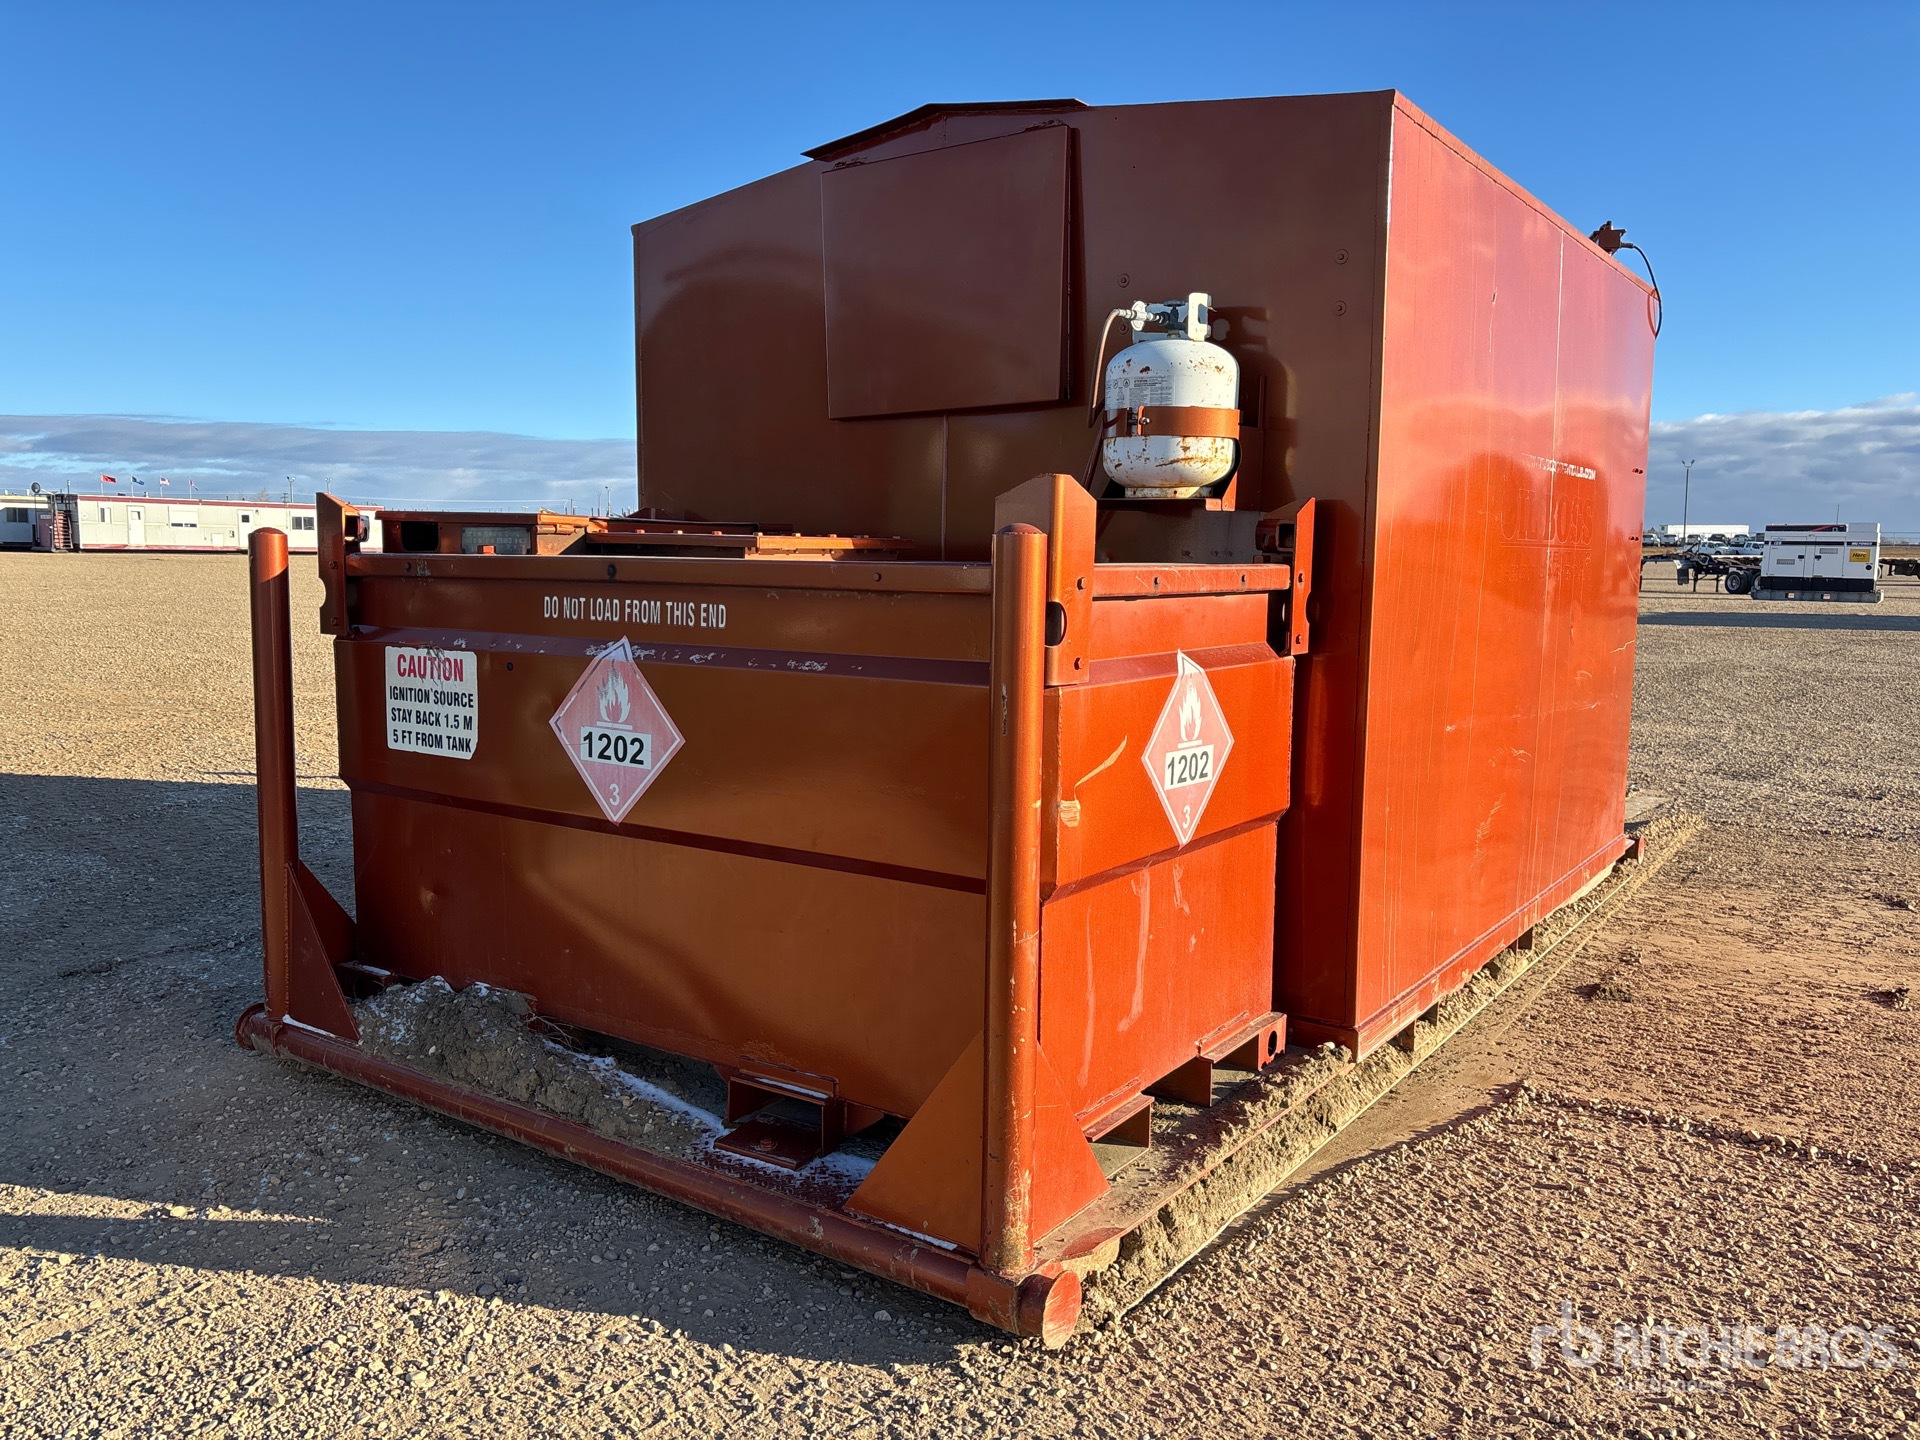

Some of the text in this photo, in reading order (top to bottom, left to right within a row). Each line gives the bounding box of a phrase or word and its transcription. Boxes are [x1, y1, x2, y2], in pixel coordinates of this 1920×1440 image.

[544, 596, 727, 628] DO NOT LOAD FROM THIS END
[397, 653, 464, 682] CAUTION
[389, 686, 474, 708] IGNITION SOURCE
[391, 707, 473, 731] STAY BACK 1.5 M
[393, 729, 472, 753] 5 FT FROM TANK
[583, 731, 645, 766] 1202
[1167, 751, 1209, 786] 1202
[609, 783, 621, 806] 3
[1182, 804, 1191, 829] 3
